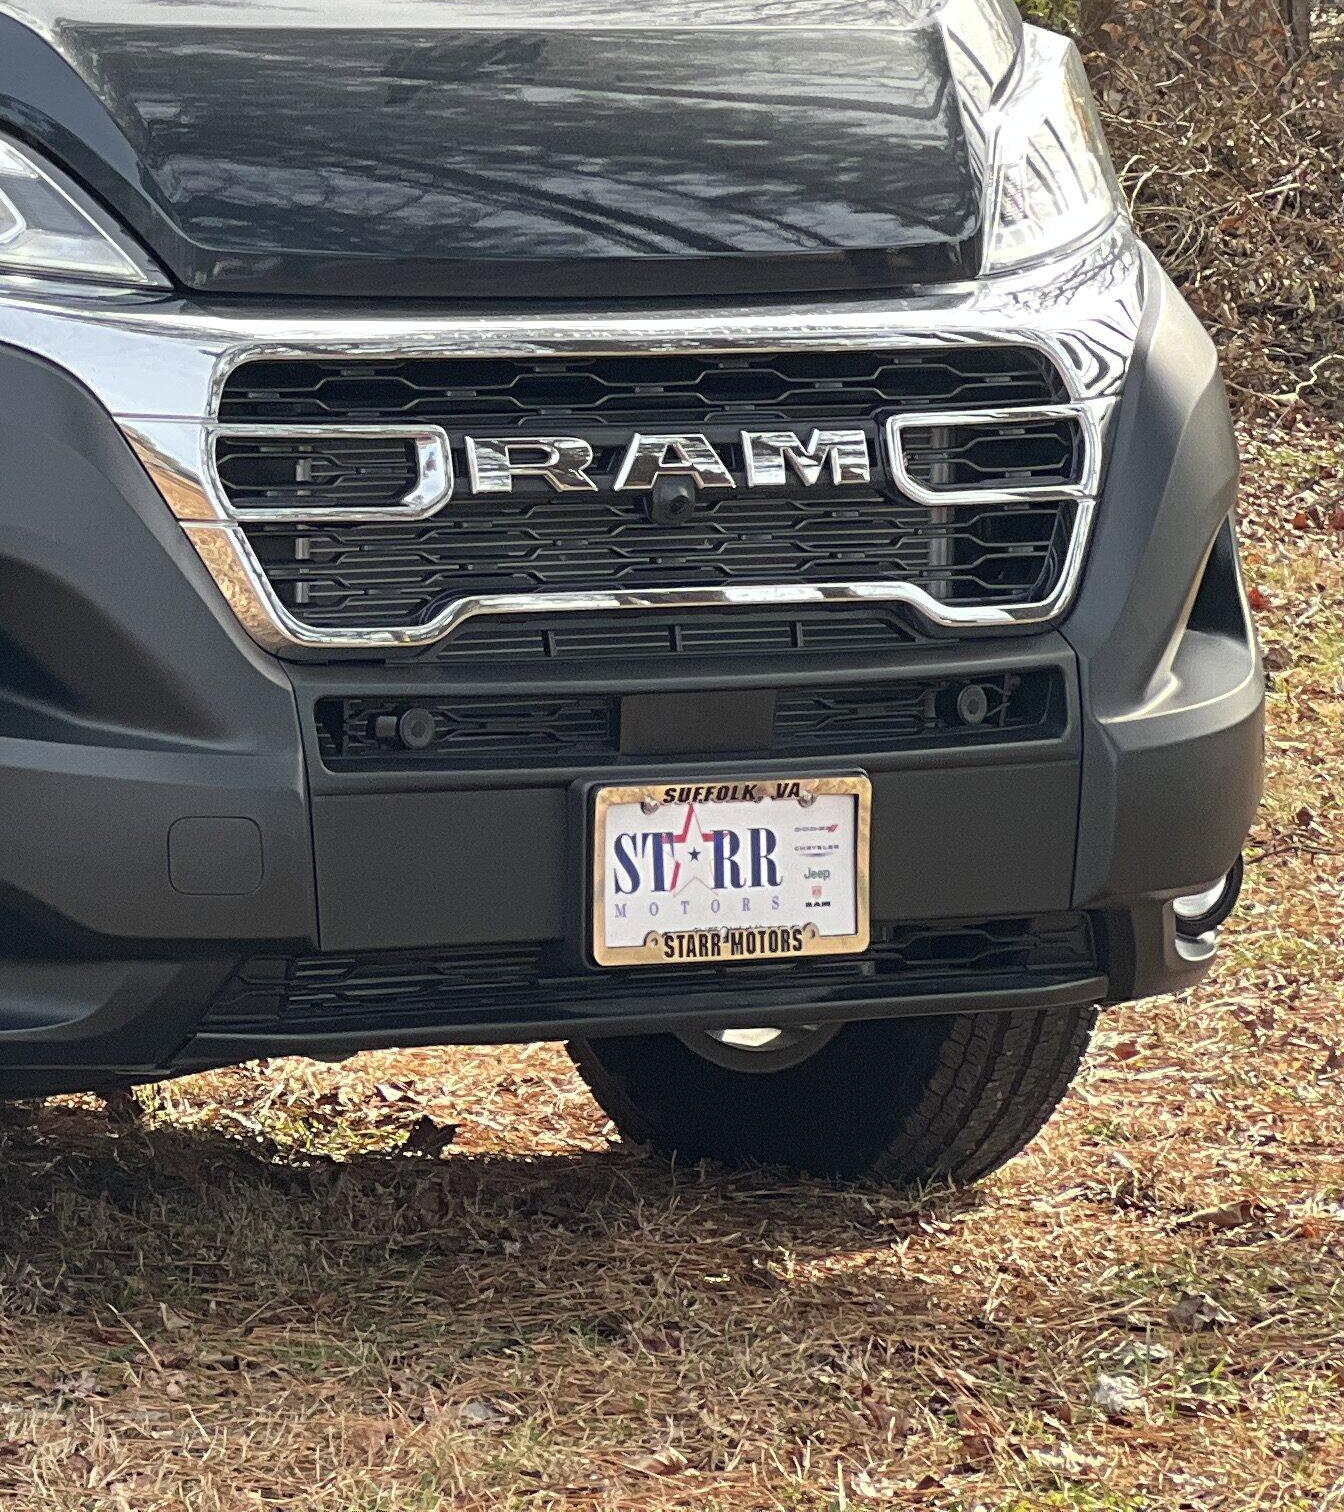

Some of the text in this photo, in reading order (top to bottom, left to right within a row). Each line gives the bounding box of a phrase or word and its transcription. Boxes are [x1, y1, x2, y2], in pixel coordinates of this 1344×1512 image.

[464, 428, 871, 493] RAM
[662, 782, 800, 804] SUFFOLK, VA
[793, 844, 840, 852] CHRYSLER
[804, 867, 831, 881] Jeep
[614, 895, 781, 918] MOTORS
[805, 900, 831, 908] RAM
[664, 928, 803, 959] STARR MOTORS
